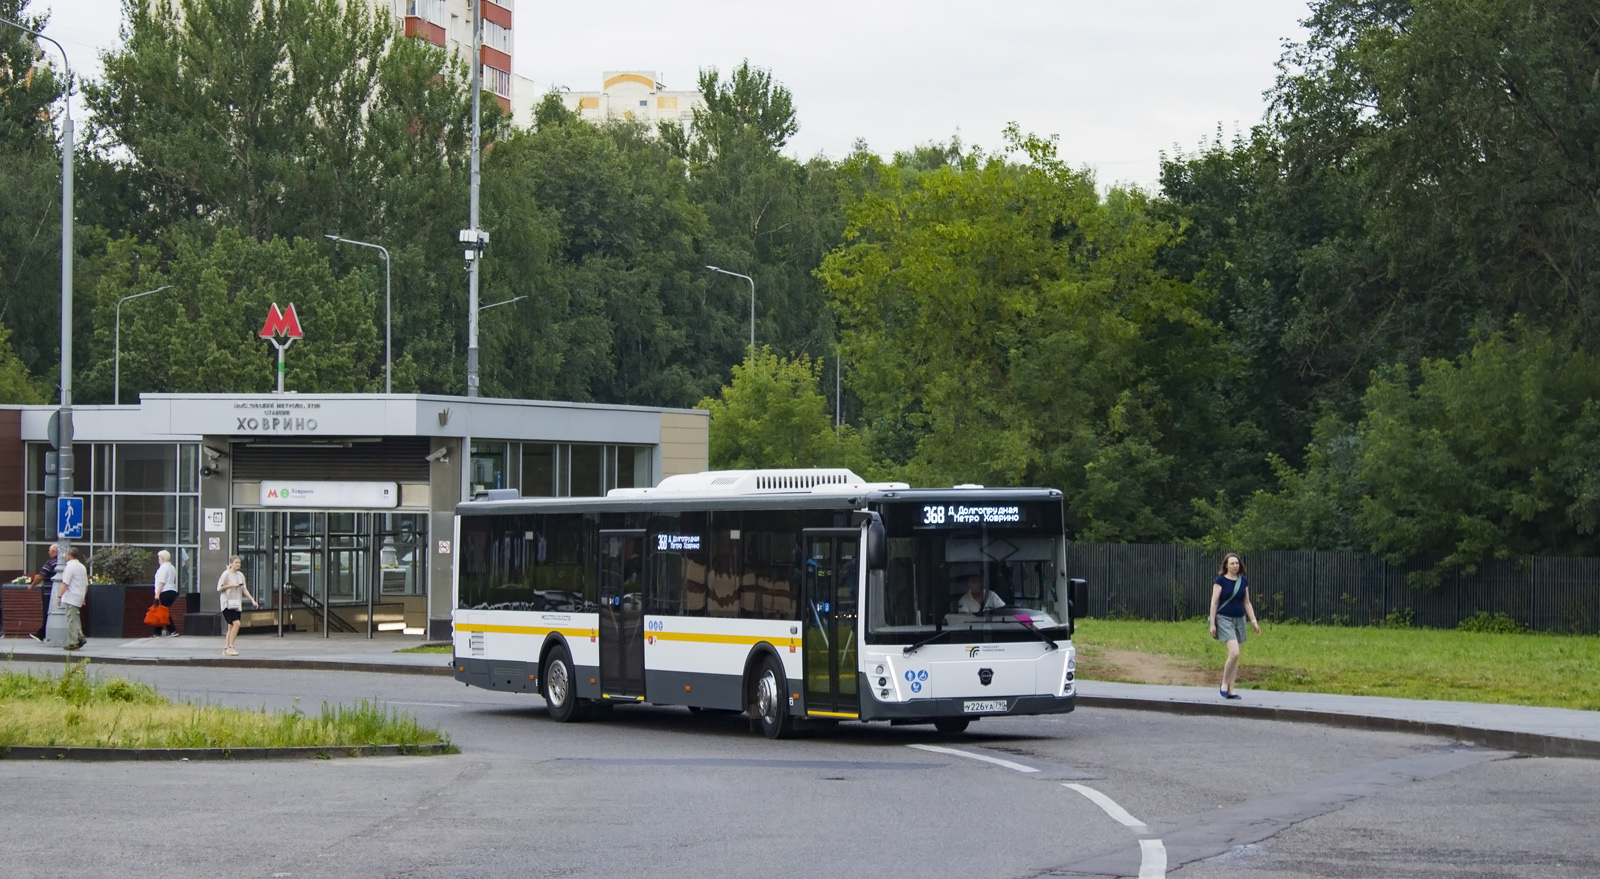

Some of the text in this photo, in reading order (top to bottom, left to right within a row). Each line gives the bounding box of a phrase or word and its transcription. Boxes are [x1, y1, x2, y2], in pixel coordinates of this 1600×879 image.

[236, 417, 318, 431] ХОВРИНО
[923, 506, 945, 524] 368
[958, 506, 1019, 515] Долгопрудная
[953, 513, 1019, 523] Метро Ховрино
